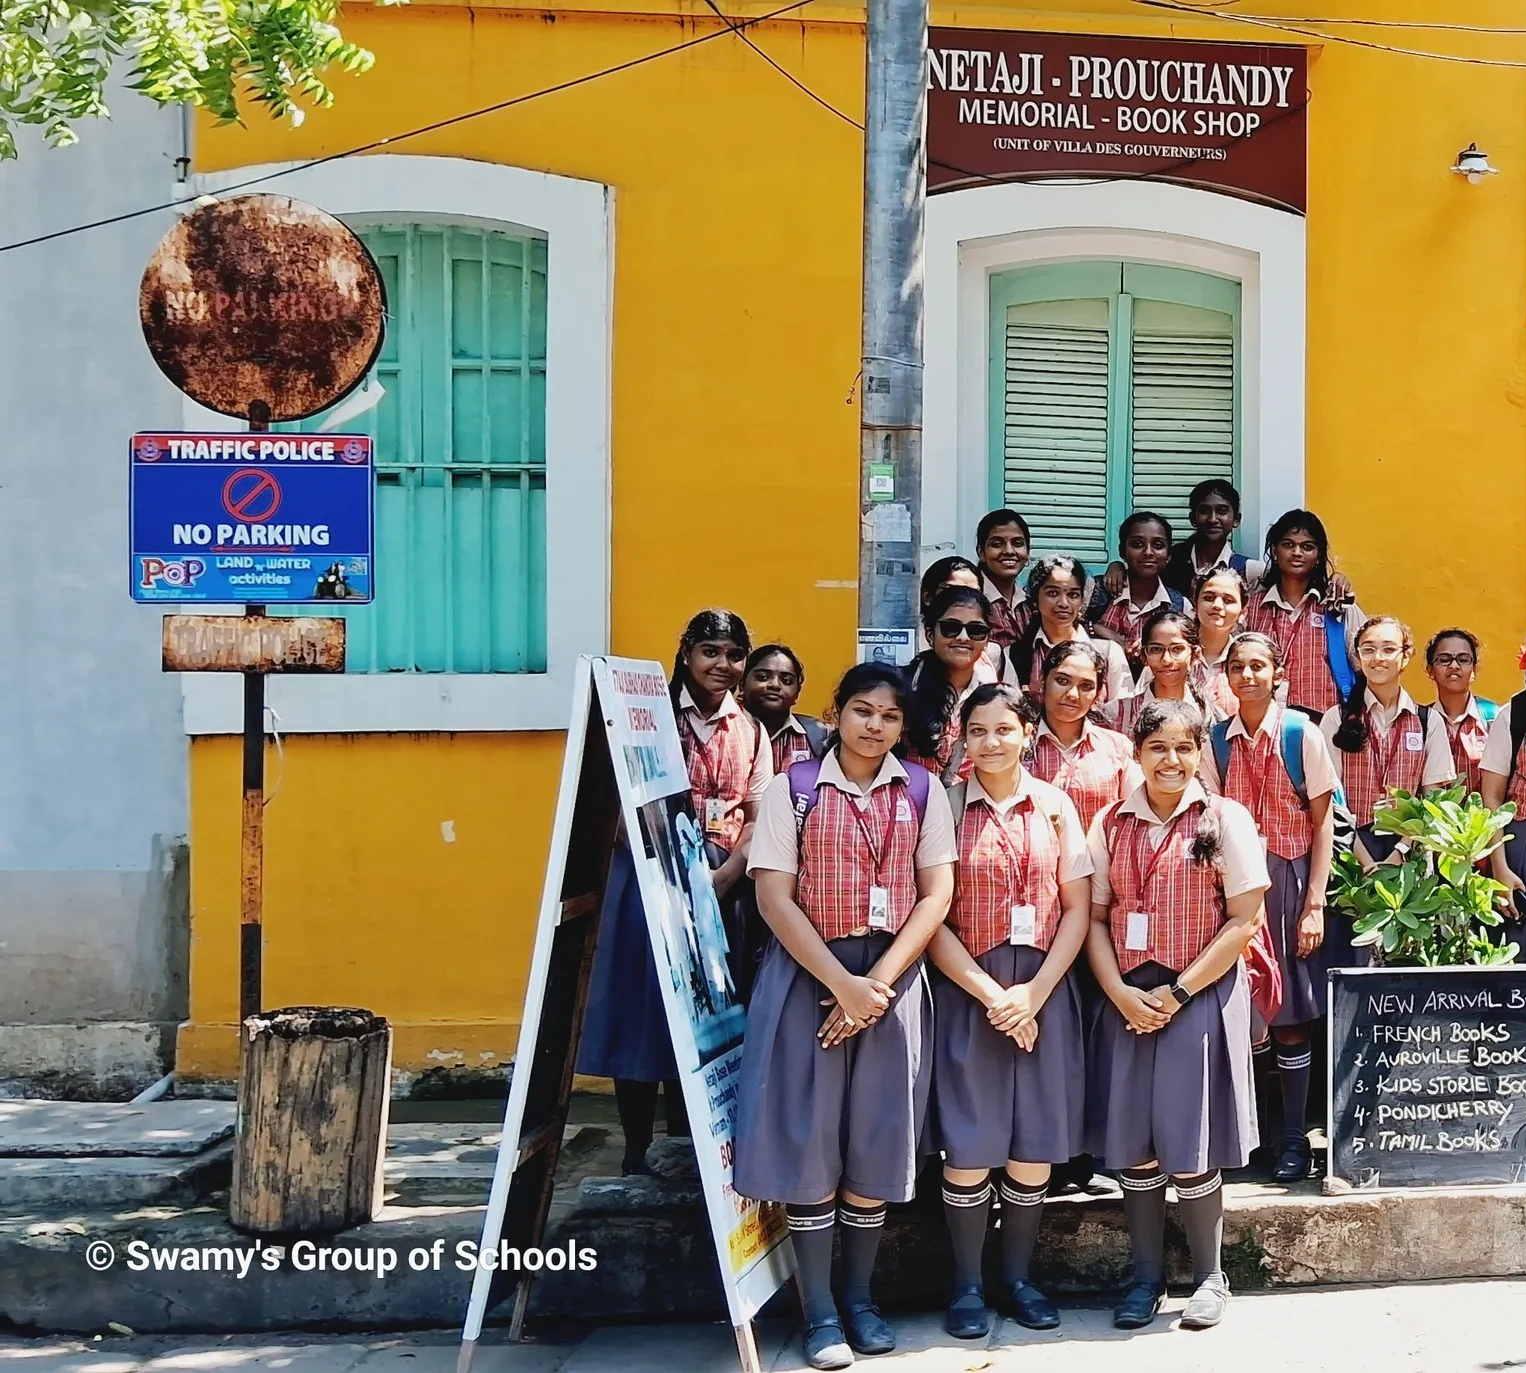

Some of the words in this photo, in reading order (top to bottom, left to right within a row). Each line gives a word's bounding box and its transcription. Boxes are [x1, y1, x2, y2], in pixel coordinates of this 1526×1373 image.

[927, 49, 1043, 95] NETAJI
[1069, 54, 1294, 108] PROUCHANDY
[958, 98, 1095, 129] MEMORIAL
[1117, 108, 1187, 135] BOOK
[1194, 110, 1260, 137] SHOP
[994, 137, 1031, 151] (UNIT
[1033, 139, 1051, 151] OF
[1053, 140, 1094, 153] VILLA
[1096, 142, 1122, 155] DES
[1124, 144, 1227, 161] GOUVERNEURS)
[165, 290, 209, 321] NO
[167, 439, 256, 460] TRAFFIC
[259, 441, 335, 461] POLICE
[173, 523, 212, 545] NO
[217, 524, 330, 546] PARKING
[216, 556, 253, 569] LAND
[266, 557, 311, 569] WATER
[229, 573, 291, 585] activities
[1367, 994, 1415, 1016] NEW
[1422, 990, 1502, 1013] ARRIVAL
[1355, 1027, 1363, 1038] 1.
[1373, 1024, 1441, 1045] FRENCH
[1354, 1054, 1368, 1068] 2.
[1375, 1048, 1470, 1068] AUROVILLE
[1354, 1080, 1369, 1094] 3.
[1377, 1076, 1422, 1096] KIDS
[1427, 1077, 1488, 1096] STORIE
[1354, 1104, 1370, 1126] 4.
[1378, 1100, 1514, 1125] PONDICHERRY
[1352, 1136, 1374, 1153] 5.
[1378, 1131, 1433, 1151] TAMIL
